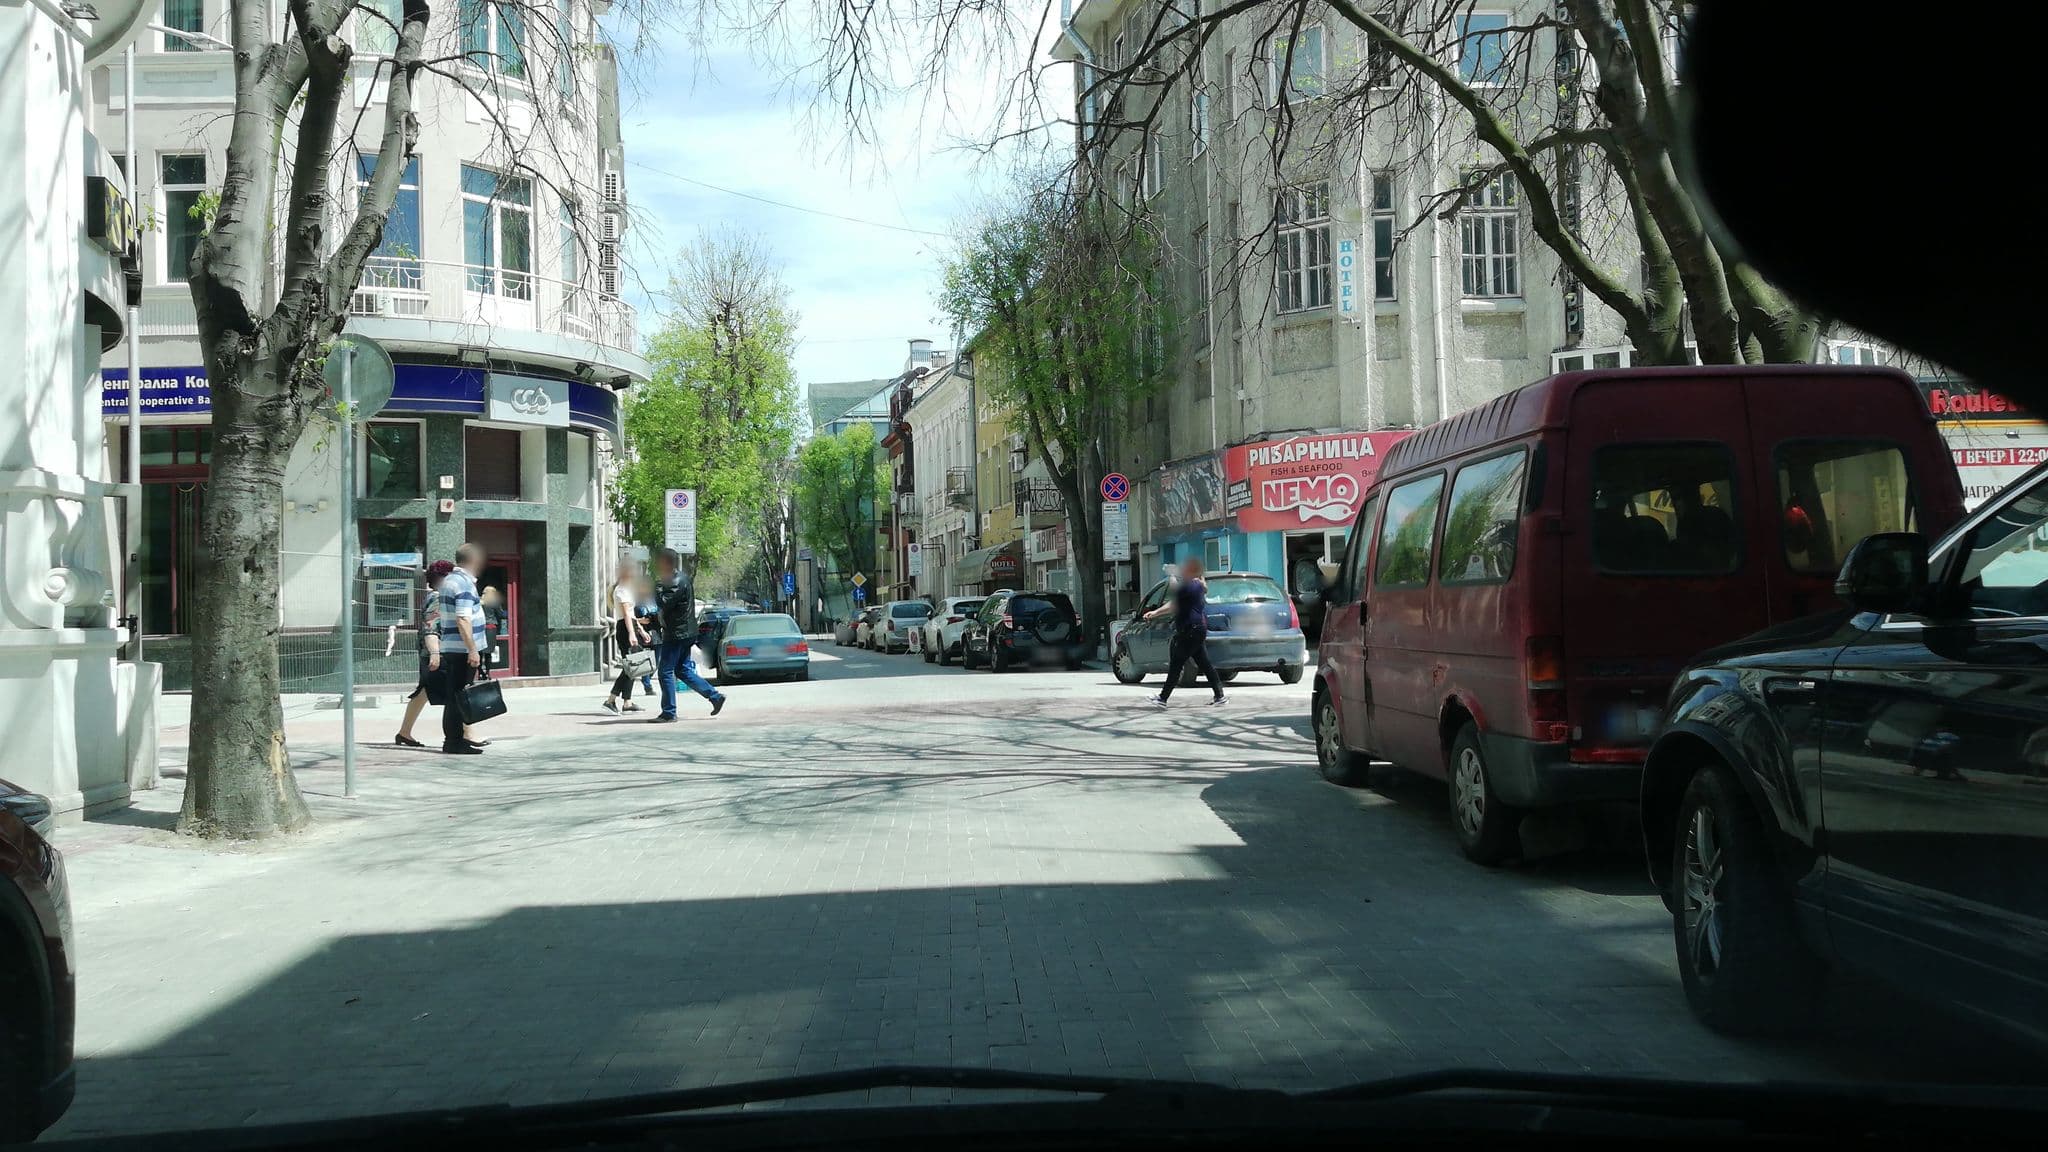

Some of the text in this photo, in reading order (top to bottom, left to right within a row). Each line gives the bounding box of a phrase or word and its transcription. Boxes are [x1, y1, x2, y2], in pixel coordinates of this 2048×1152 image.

[1340, 240, 1353, 312] HOTEL
[139, 395, 194, 408] ooperative
[197, 395, 211, 405] Ba
[1249, 437, 1375, 466] РИБАРНИЦА
[1966, 449, 2006, 464] ВЕЧЕР
[2018, 449, 2048, 463] 22:0
[1270, 467, 1289, 476] FISH
[1298, 462, 1344, 474] SEAFOOD
[1262, 473, 1359, 511] NEMO
[991, 560, 1017, 568] HOTEL
